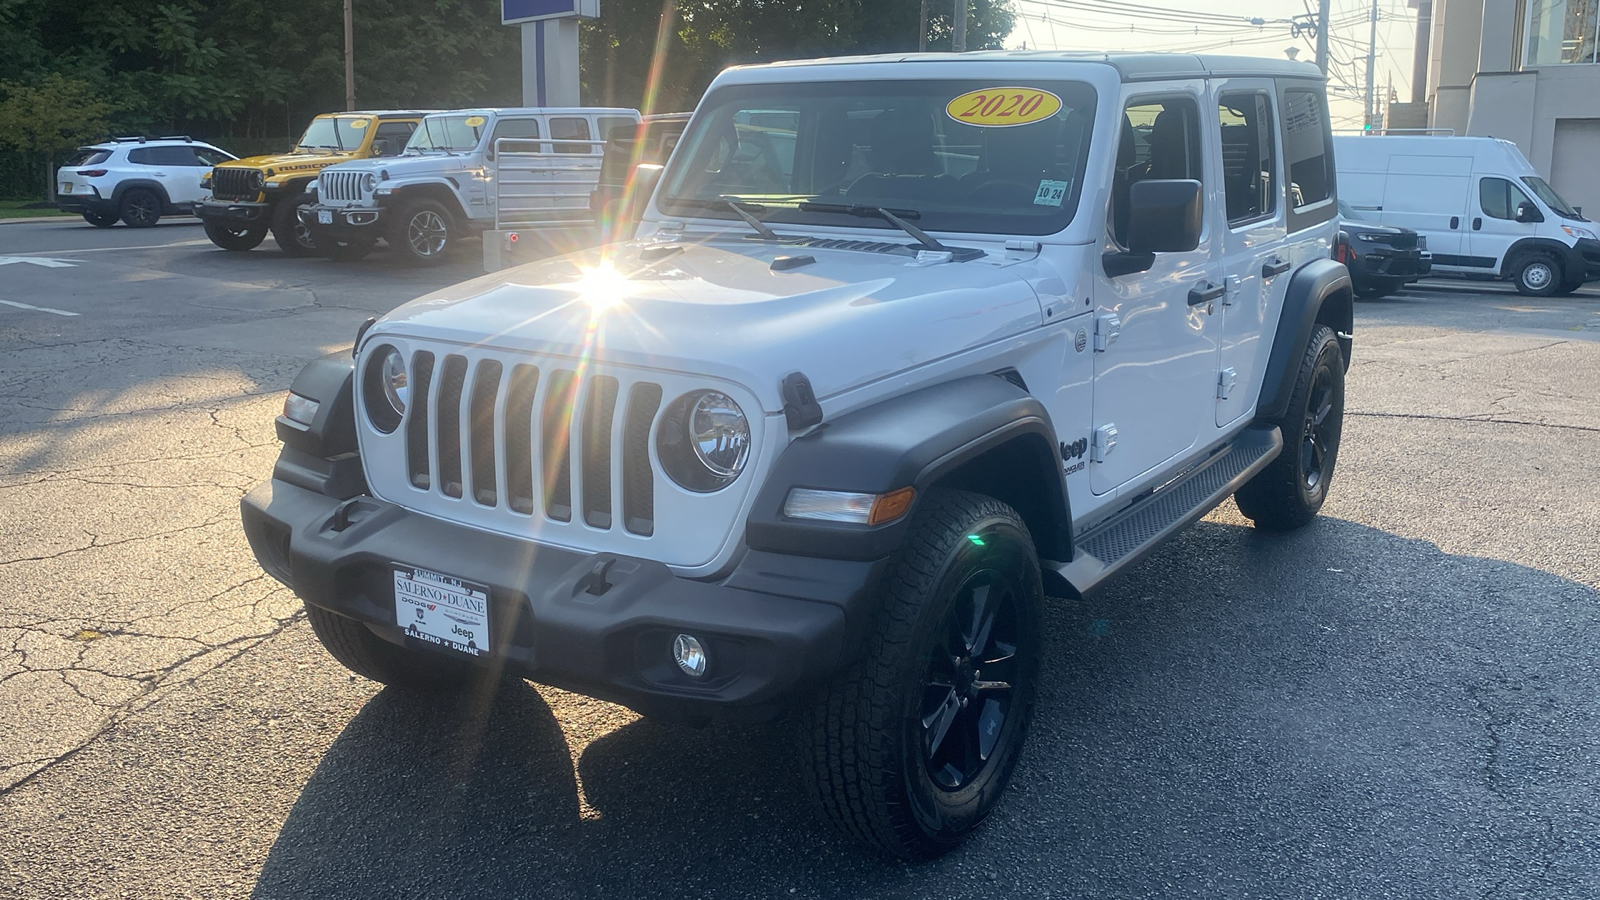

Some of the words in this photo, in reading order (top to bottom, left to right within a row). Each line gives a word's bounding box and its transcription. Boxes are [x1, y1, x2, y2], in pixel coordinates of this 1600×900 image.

[959, 94, 1044, 117] 2020
[1038, 187, 1049, 198] 10
[1051, 189, 1063, 200] 24
[396, 579, 442, 601] SALERNO
[447, 593, 485, 614] DUANE
[404, 628, 441, 645] SALERNO
[452, 642, 480, 656] DUANE
[451, 624, 474, 640] Jeep
